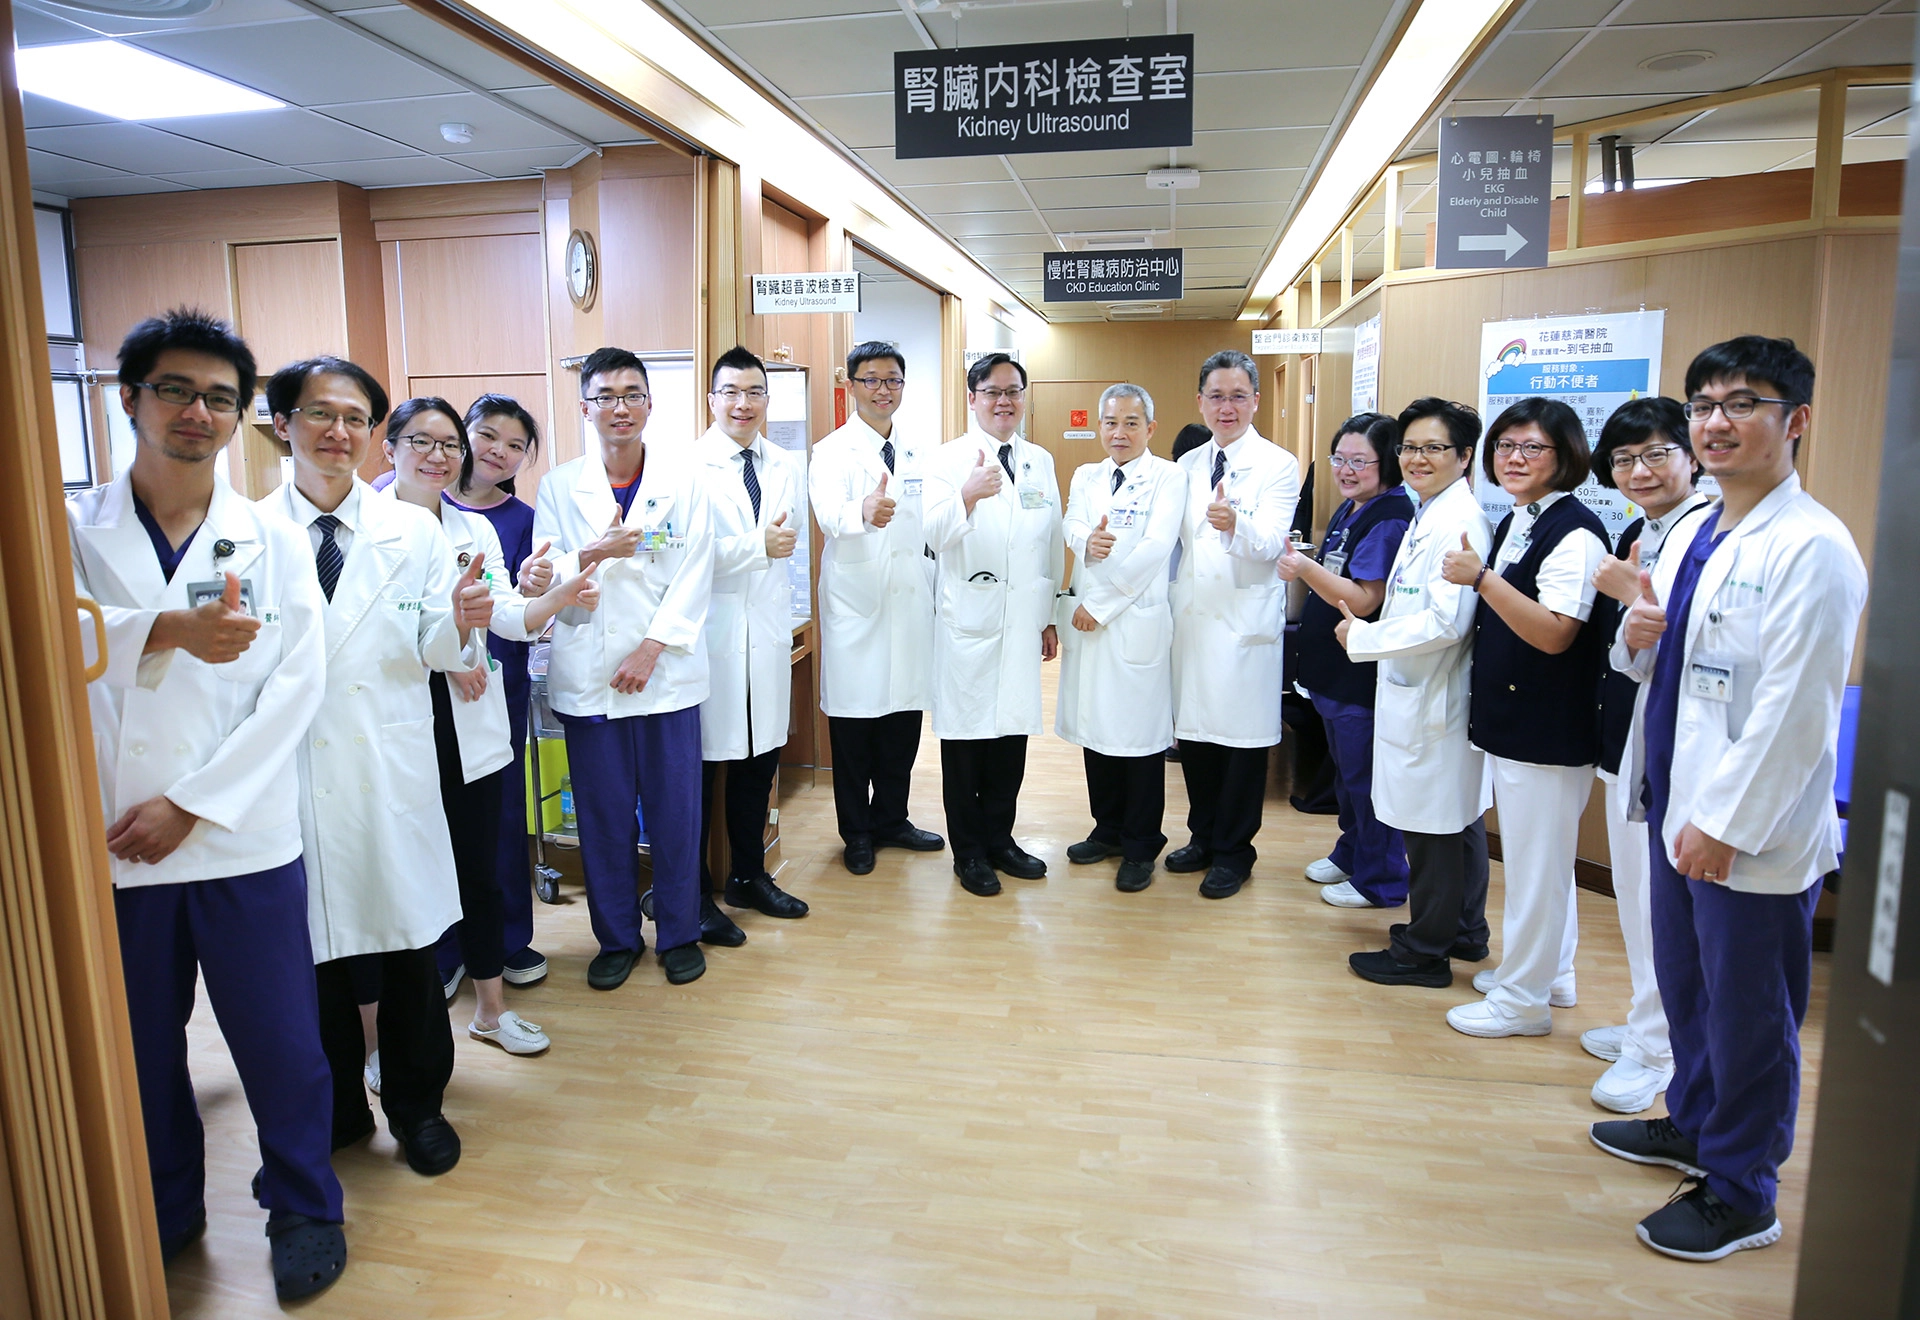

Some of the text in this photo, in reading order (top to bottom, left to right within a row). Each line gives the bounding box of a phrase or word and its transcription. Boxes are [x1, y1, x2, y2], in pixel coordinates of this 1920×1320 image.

[903, 52, 1188, 114] 腎臟內科檢查室
[957, 108, 1131, 141] Kidney Ultrasound
[1462, 167, 1529, 182] 小兒抽血
[1484, 184, 1505, 194] EKG
[1450, 195, 1540, 207] Elderly and Disable
[1480, 208, 1507, 218] Child
[1046, 256, 1180, 281] 慢性腎臟病防治中心
[756, 278, 855, 296] 腎臟超音波檢查室
[1065, 280, 1161, 294] CKD Education Clinic
[774, 296, 837, 308] Kidney Ultrasound
[1539, 327, 1608, 342] 花蓮慈濟醫院
[1529, 374, 1599, 390] 行動不便者
